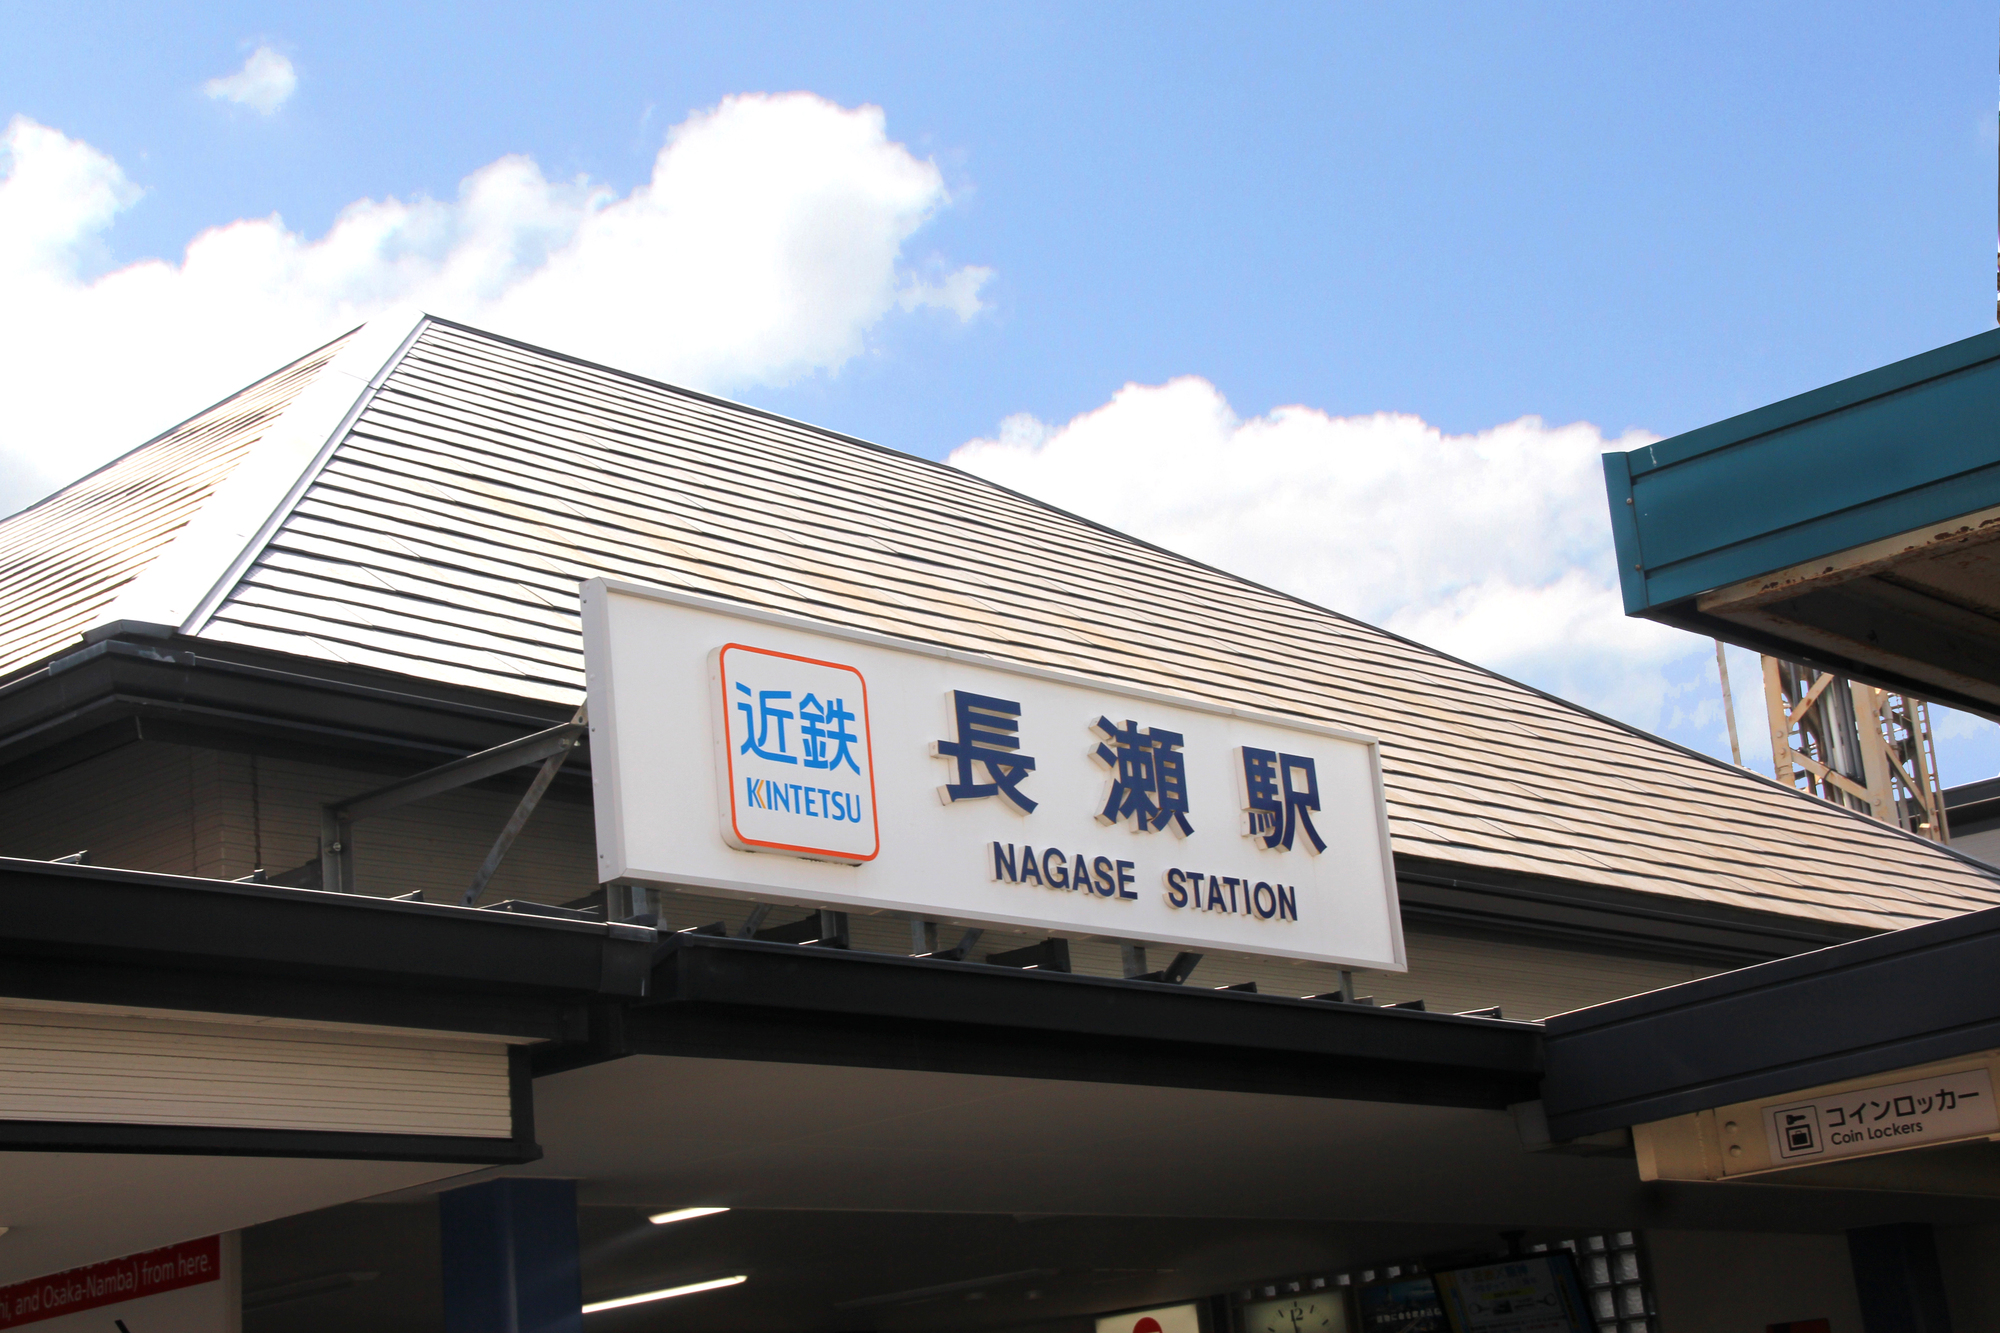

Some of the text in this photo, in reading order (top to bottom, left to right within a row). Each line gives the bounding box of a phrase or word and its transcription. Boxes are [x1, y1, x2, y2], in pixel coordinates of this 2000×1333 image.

[735, 682, 861, 776] 近鉄
[746, 776, 862, 824] KINTETSU
[934, 690, 1327, 857] 長瀬駅
[991, 841, 1298, 922] NAGASE STATION
[1826, 1088, 1980, 1128] コインロッカー
[1831, 1121, 1924, 1146] Coin Lockers
[15, 1288, 40, 1315] and
[43, 1261, 139, 1309] Osaka-Namba)
[142, 1260, 175, 1286] from
[178, 1253, 212, 1278] here.
